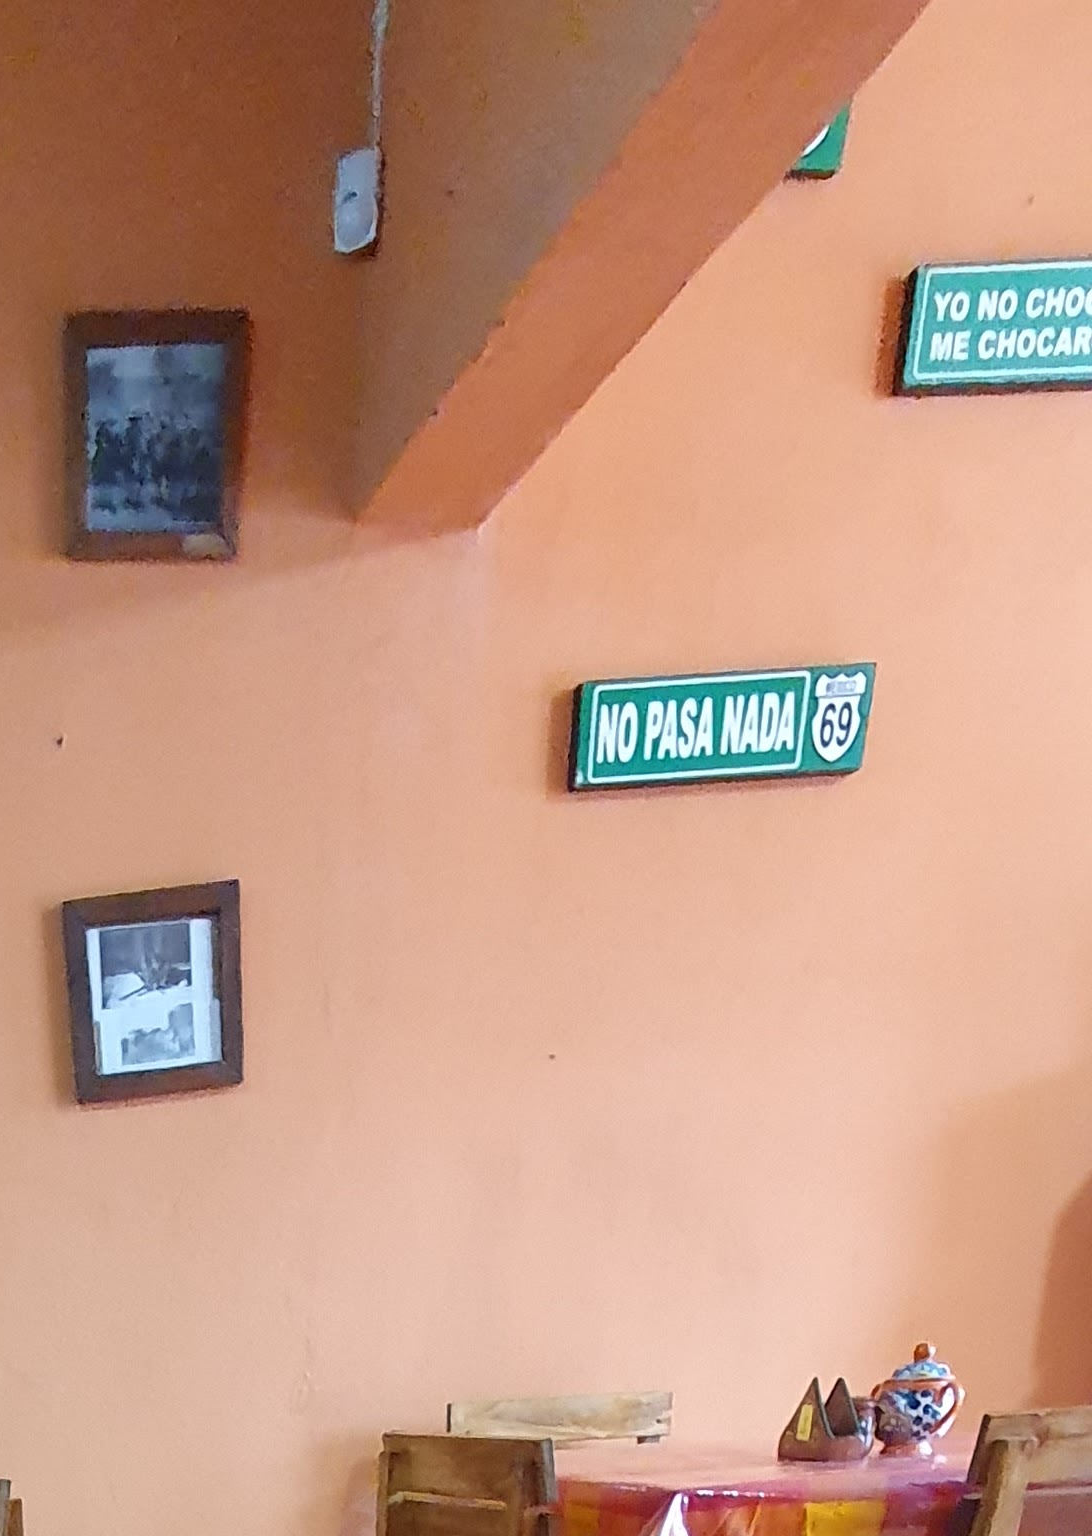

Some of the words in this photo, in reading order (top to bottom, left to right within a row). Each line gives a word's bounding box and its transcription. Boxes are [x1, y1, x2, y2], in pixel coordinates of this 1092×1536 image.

[933, 290, 970, 321] YO
[977, 288, 1019, 321] NO
[929, 330, 971, 361] ME
[977, 326, 1092, 360] CHOCAR
[596, 703, 638, 763] NO
[643, 697, 714, 760] PASA
[720, 691, 795, 755] NADA
[819, 701, 853, 748] 69
